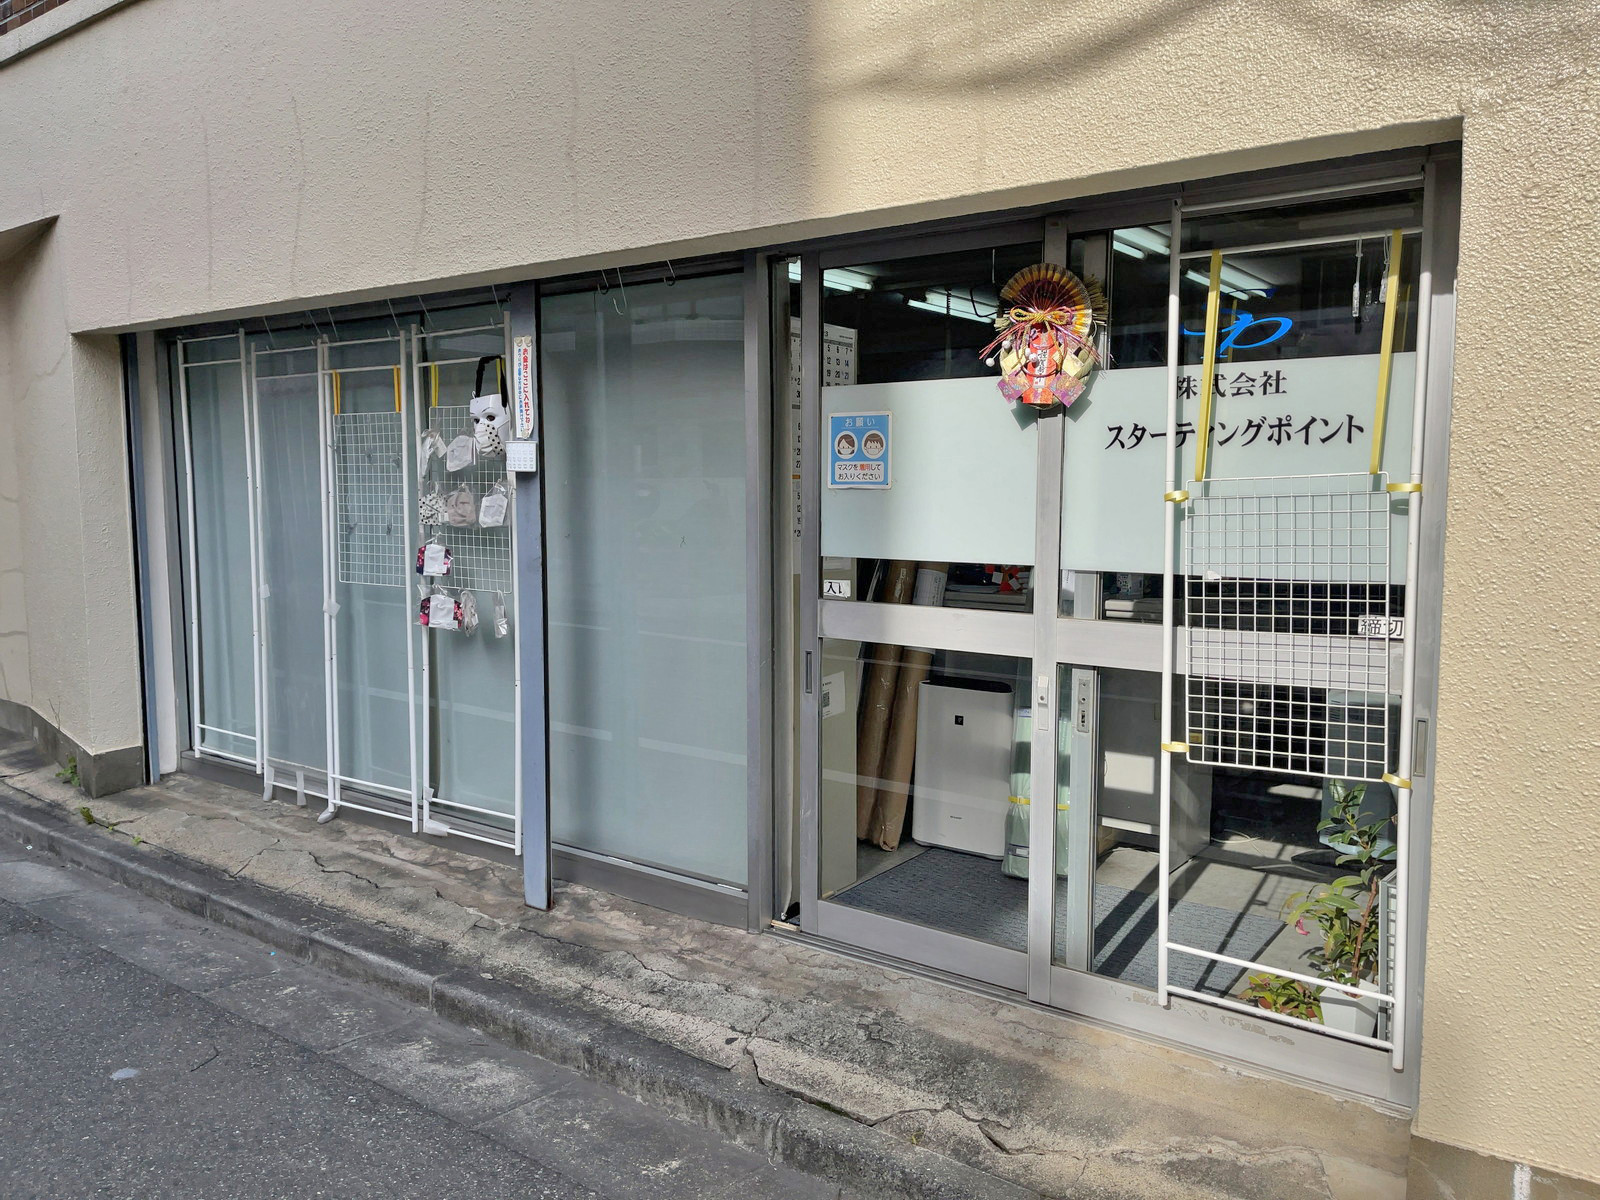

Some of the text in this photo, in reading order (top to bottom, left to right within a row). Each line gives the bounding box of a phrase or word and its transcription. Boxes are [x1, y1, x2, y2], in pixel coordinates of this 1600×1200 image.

[1176, 369, 1288, 400] 株式会社
[844, 416, 876, 428] お願い
[837, 463, 882, 472] マスクを着用して
[838, 472, 881, 481] お入りください
